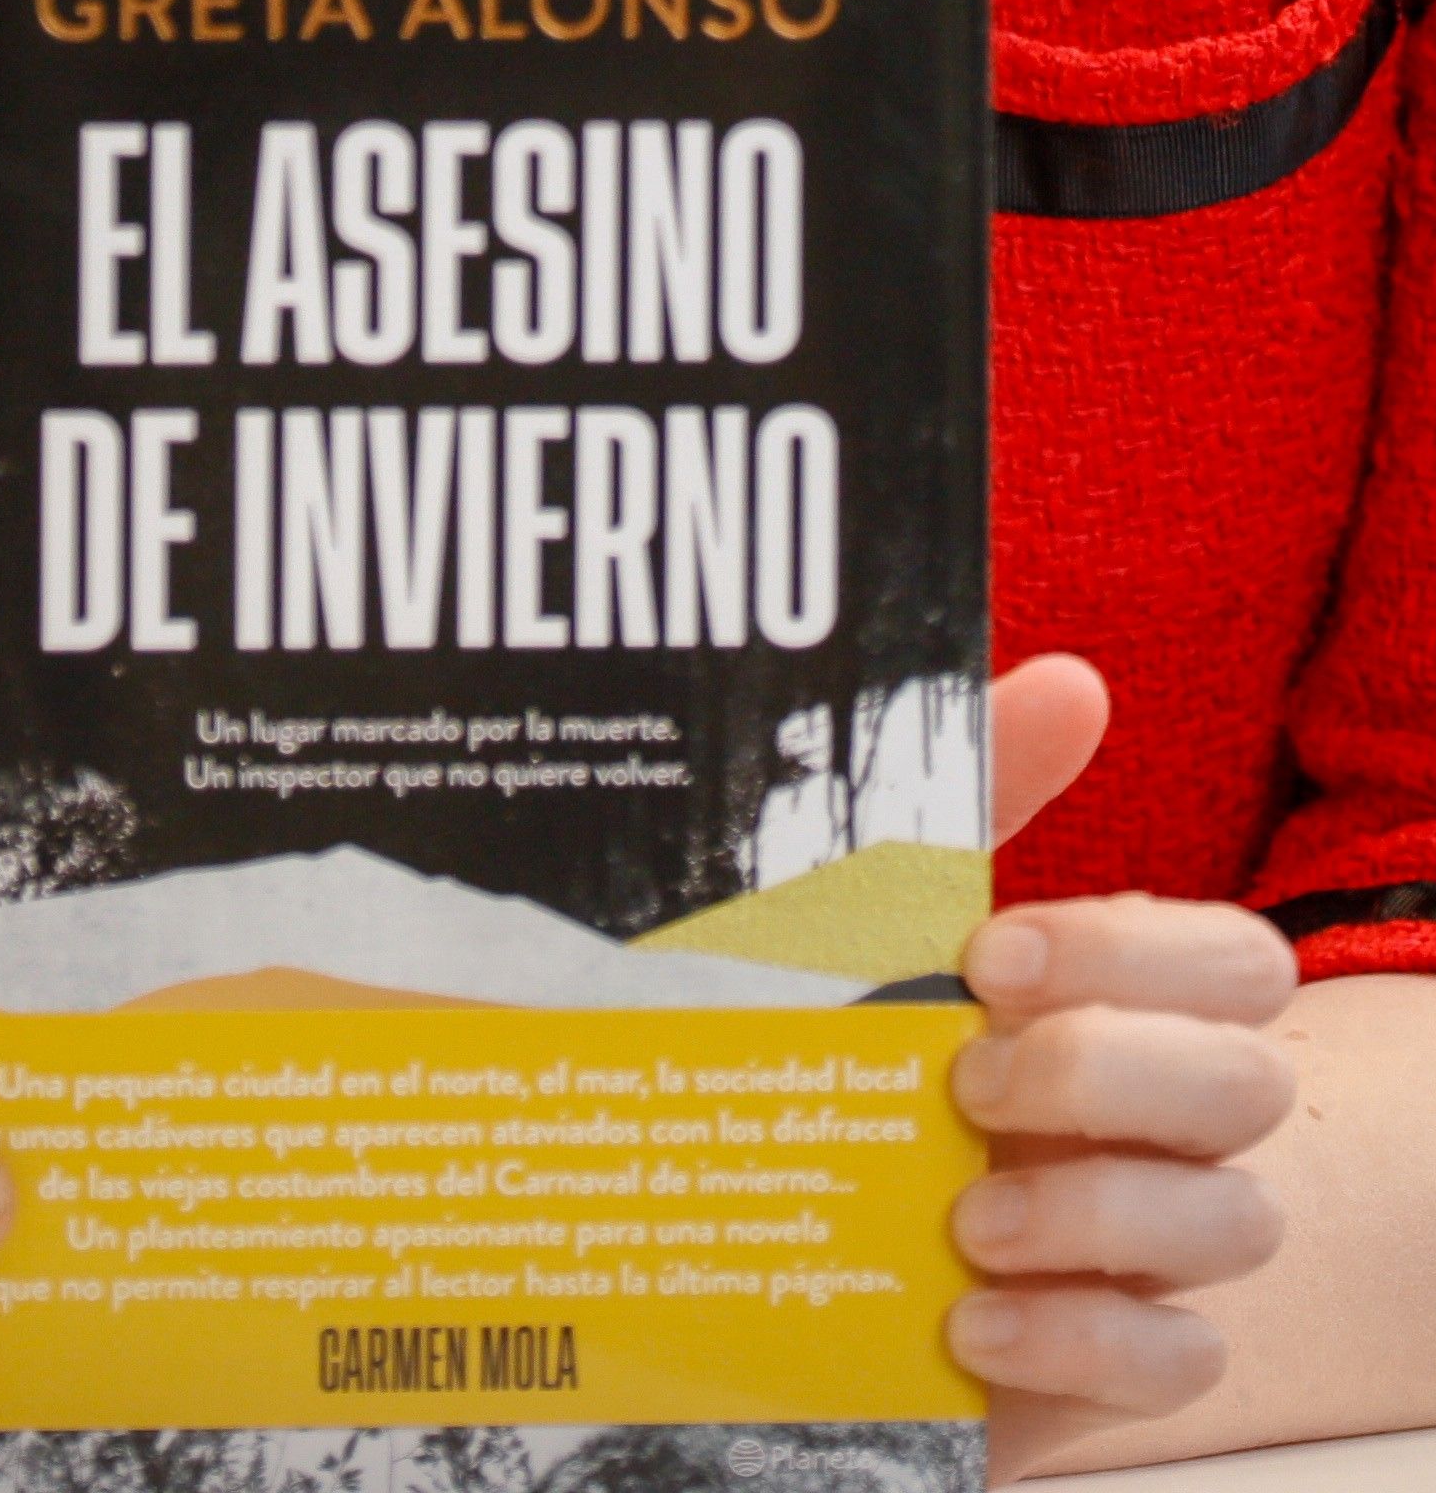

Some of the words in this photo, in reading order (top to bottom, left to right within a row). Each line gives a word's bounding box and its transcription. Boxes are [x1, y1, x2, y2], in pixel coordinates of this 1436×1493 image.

[79, 121, 217, 366] EL
[240, 118, 803, 365] ASESINO
[39, 407, 199, 652] DE
[233, 403, 840, 649] INVIERNO
[197, 710, 246, 744] Un
[251, 710, 322, 755] lugar
[331, 708, 461, 743] marcado
[467, 716, 521, 752] por
[526, 708, 554, 742] la
[558, 713, 681, 742] muerte.
[184, 755, 234, 789] Un
[239, 755, 378, 799] inspector
[384, 764, 439, 798] que
[448, 763, 487, 787] no
[493, 752, 588, 798] quiere
[594, 753, 693, 787] volver.
[73, 1062, 215, 1111] pequeña
[223, 1062, 333, 1097] ciudad
[341, 1072, 381, 1097] en
[389, 1062, 421, 1097] el
[430, 1068, 530, 1101] norte,
[538, 1059, 568, 1095] el
[577, 1068, 650, 1101] mar,
[657, 1059, 684, 1094] la
[694, 1058, 836, 1094] sociedad
[843, 1058, 922, 1092] local
[9, 1126, 86, 1149] unos
[264, 1125, 325, 1159] que
[334, 1122, 482, 1158] aparecen
[492, 1110, 641, 1145] ataviados
[649, 1119, 709, 1144] con
[719, 1109, 763, 1143] los
[772, 1107, 916, 1143] disfraces
[38, 1167, 78, 1200] de
[88, 1167, 132, 1200] las
[140, 1167, 229, 1213] viejas
[238, 1166, 426, 1199] costumbres
[437, 1161, 486, 1197] del
[495, 1160, 641, 1196] Carnaval
[649, 1161, 688, 1195] de
[67, 1217, 117, 1250] Un
[126, 1213, 363, 1262] planteamiento
[373, 1215, 564, 1259] apasionante
[574, 1222, 646, 1258] para
[656, 1221, 716, 1246] una
[725, 1211, 830, 1244] novela
[61, 1279, 103, 1301] no
[112, 1268, 240, 1312] permite
[251, 1265, 375, 1311] respirar
[383, 1265, 411, 1299] al
[421, 1265, 515, 1298] lector
[524, 1262, 611, 1296] hasta
[620, 1262, 648, 1296] la
[657, 1260, 762, 1295] última
[319, 1325, 467, 1392] CARMEN
[480, 1325, 579, 1391] MOLA
